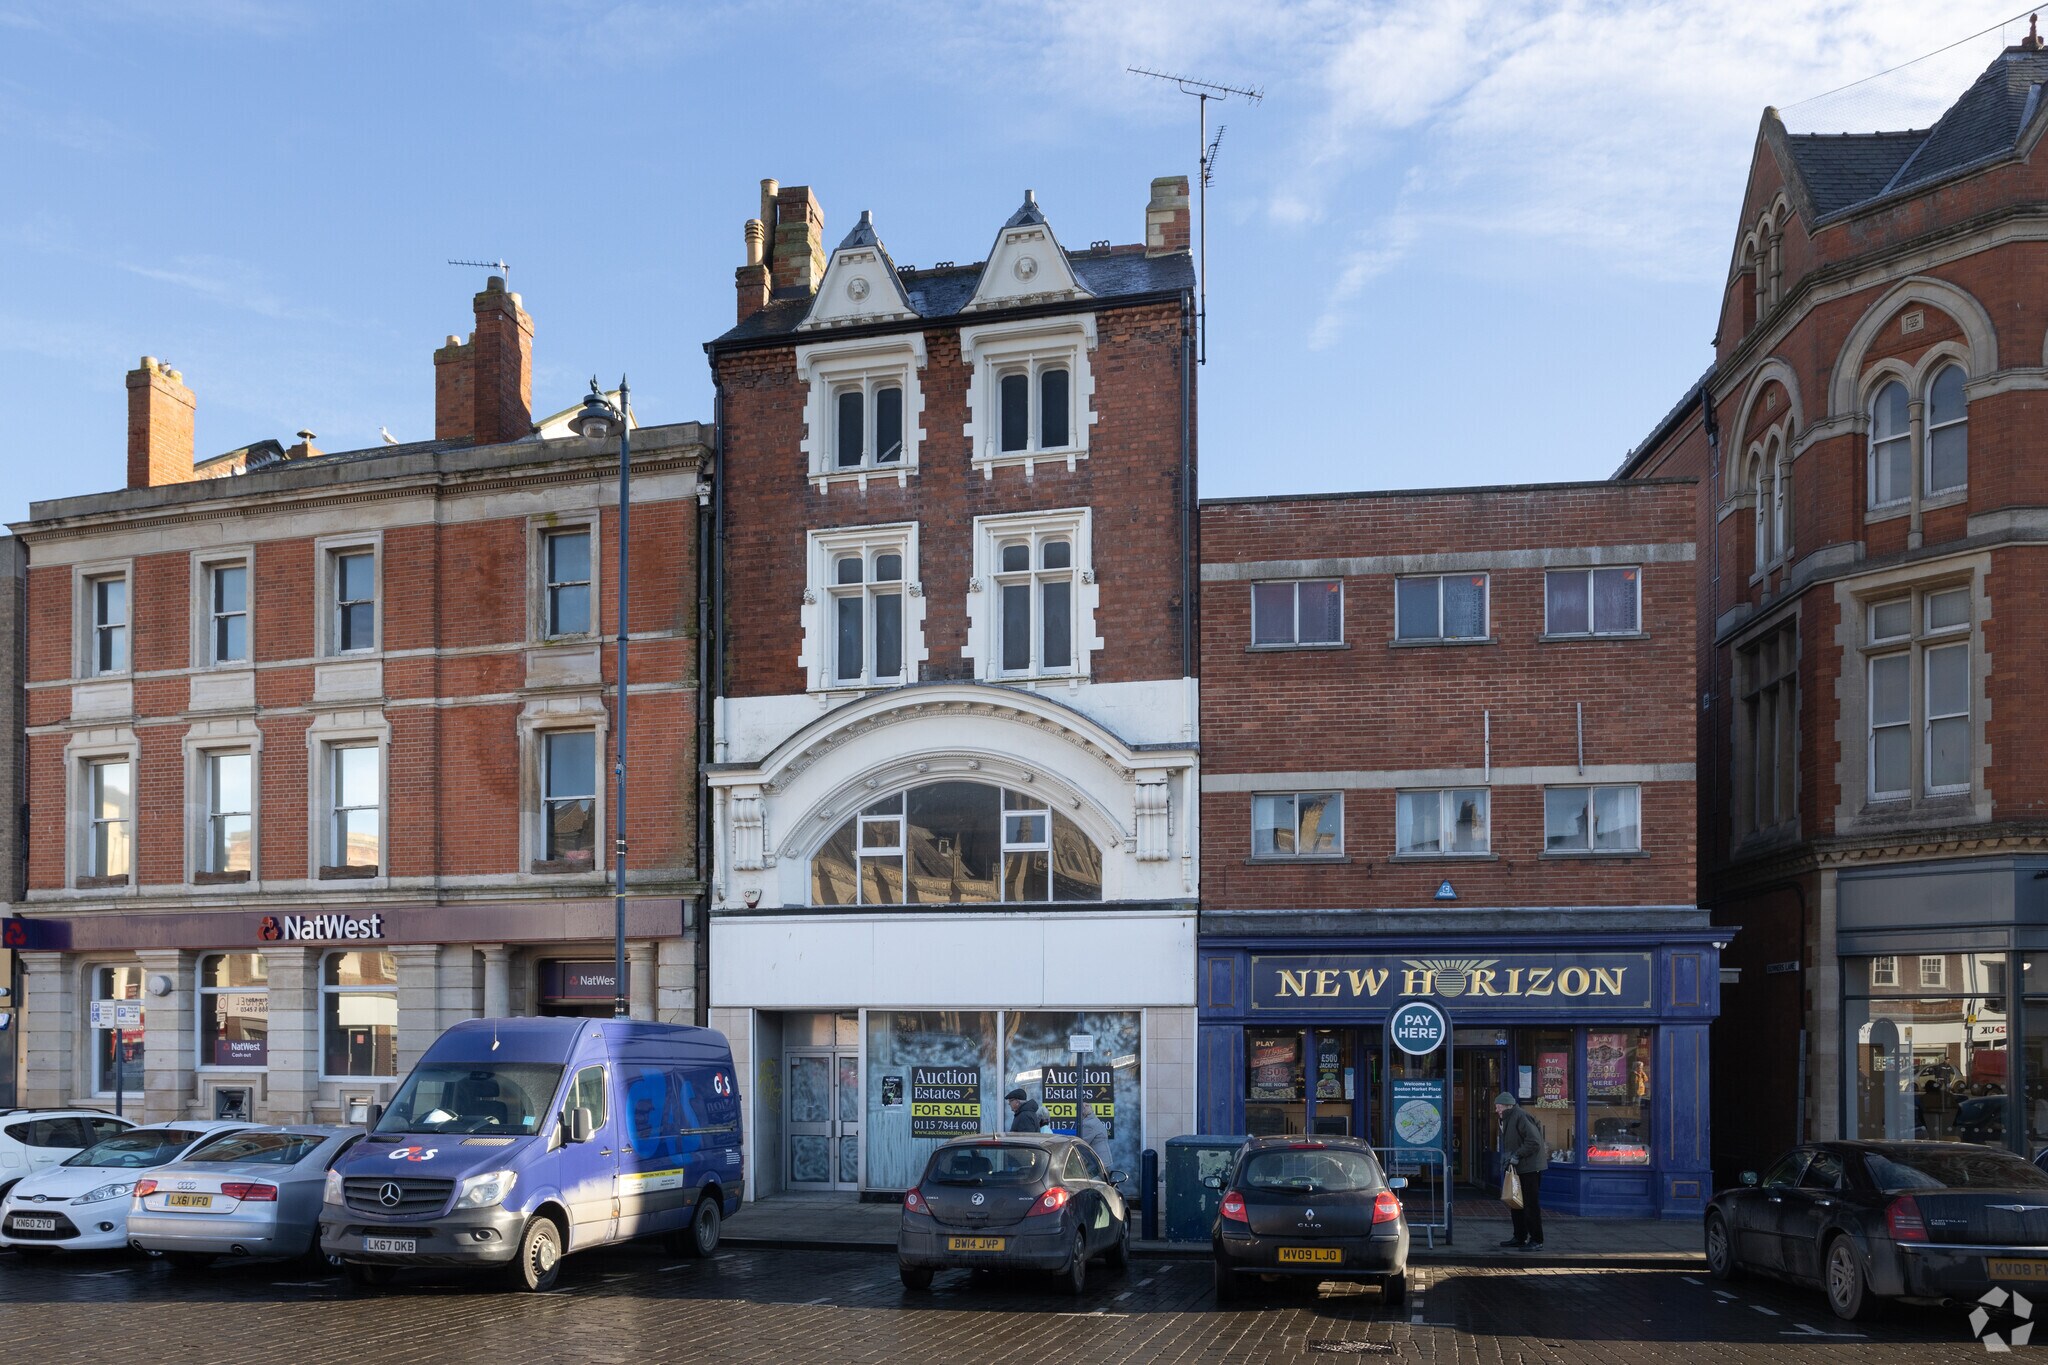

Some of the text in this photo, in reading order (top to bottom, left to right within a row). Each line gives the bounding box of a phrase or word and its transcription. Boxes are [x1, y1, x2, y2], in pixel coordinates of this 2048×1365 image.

[284, 913, 381, 940] NatWest
[580, 975, 616, 986] NatWes
[1274, 967, 1628, 997] NEW HORIZON
[1404, 1014, 1432, 1026] PAY
[1398, 1027, 1438, 1039] HERE
[231, 1042, 260, 1051] NatWest
[1321, 1054, 1338, 1063] £500
[1591, 1065, 1616, 1073] £500
[914, 1068, 978, 1085] Auction
[1045, 1068, 1111, 1084] Aucion
[713, 1071, 731, 1097] G4S
[914, 1086, 961, 1100] Estates
[1543, 1087, 1561, 1095] £500
[914, 1104, 978, 1116] FOR SALE
[914, 1120, 978, 1130] 0115 7844 600
[1049, 1121, 1068, 1130] 115
[388, 1146, 439, 1162] G4S
[171, 1195, 190, 1206] LX61
[192, 1195, 209, 1206] VFO
[16, 1218, 52, 1229] KN60 ZYO
[368, 1239, 414, 1252] LK67 OKB
[954, 1239, 999, 1249] BW14 JVP
[1283, 1249, 1337, 1261] MV09 LJO
